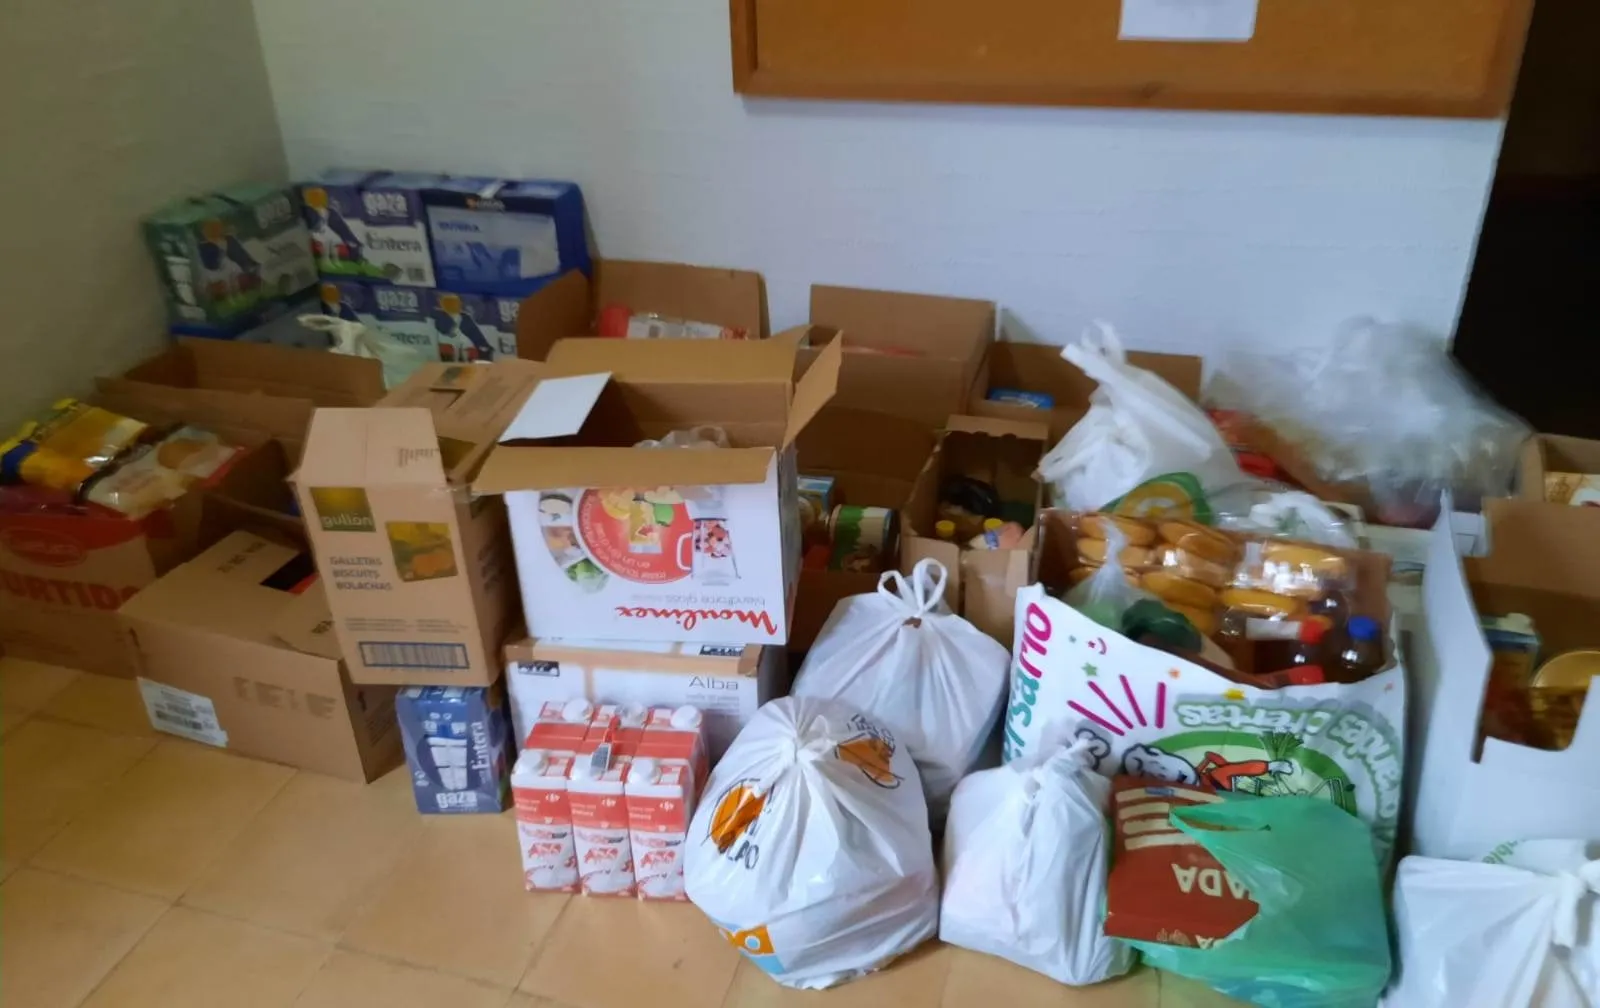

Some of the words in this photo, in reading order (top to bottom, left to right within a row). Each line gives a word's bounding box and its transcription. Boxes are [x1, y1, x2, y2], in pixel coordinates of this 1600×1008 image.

[363, 190, 408, 216] gaza
[364, 231, 424, 253] Entera
[376, 289, 418, 312] gaza
[330, 556, 383, 567] GALLETAS
[332, 569, 381, 579] BISCUITS
[335, 581, 394, 591] BOLACHAS
[615, 605, 778, 636] Moulinex
[688, 675, 739, 691] Alba
[470, 721, 490, 771] Entera
[435, 791, 478, 809] gaza
